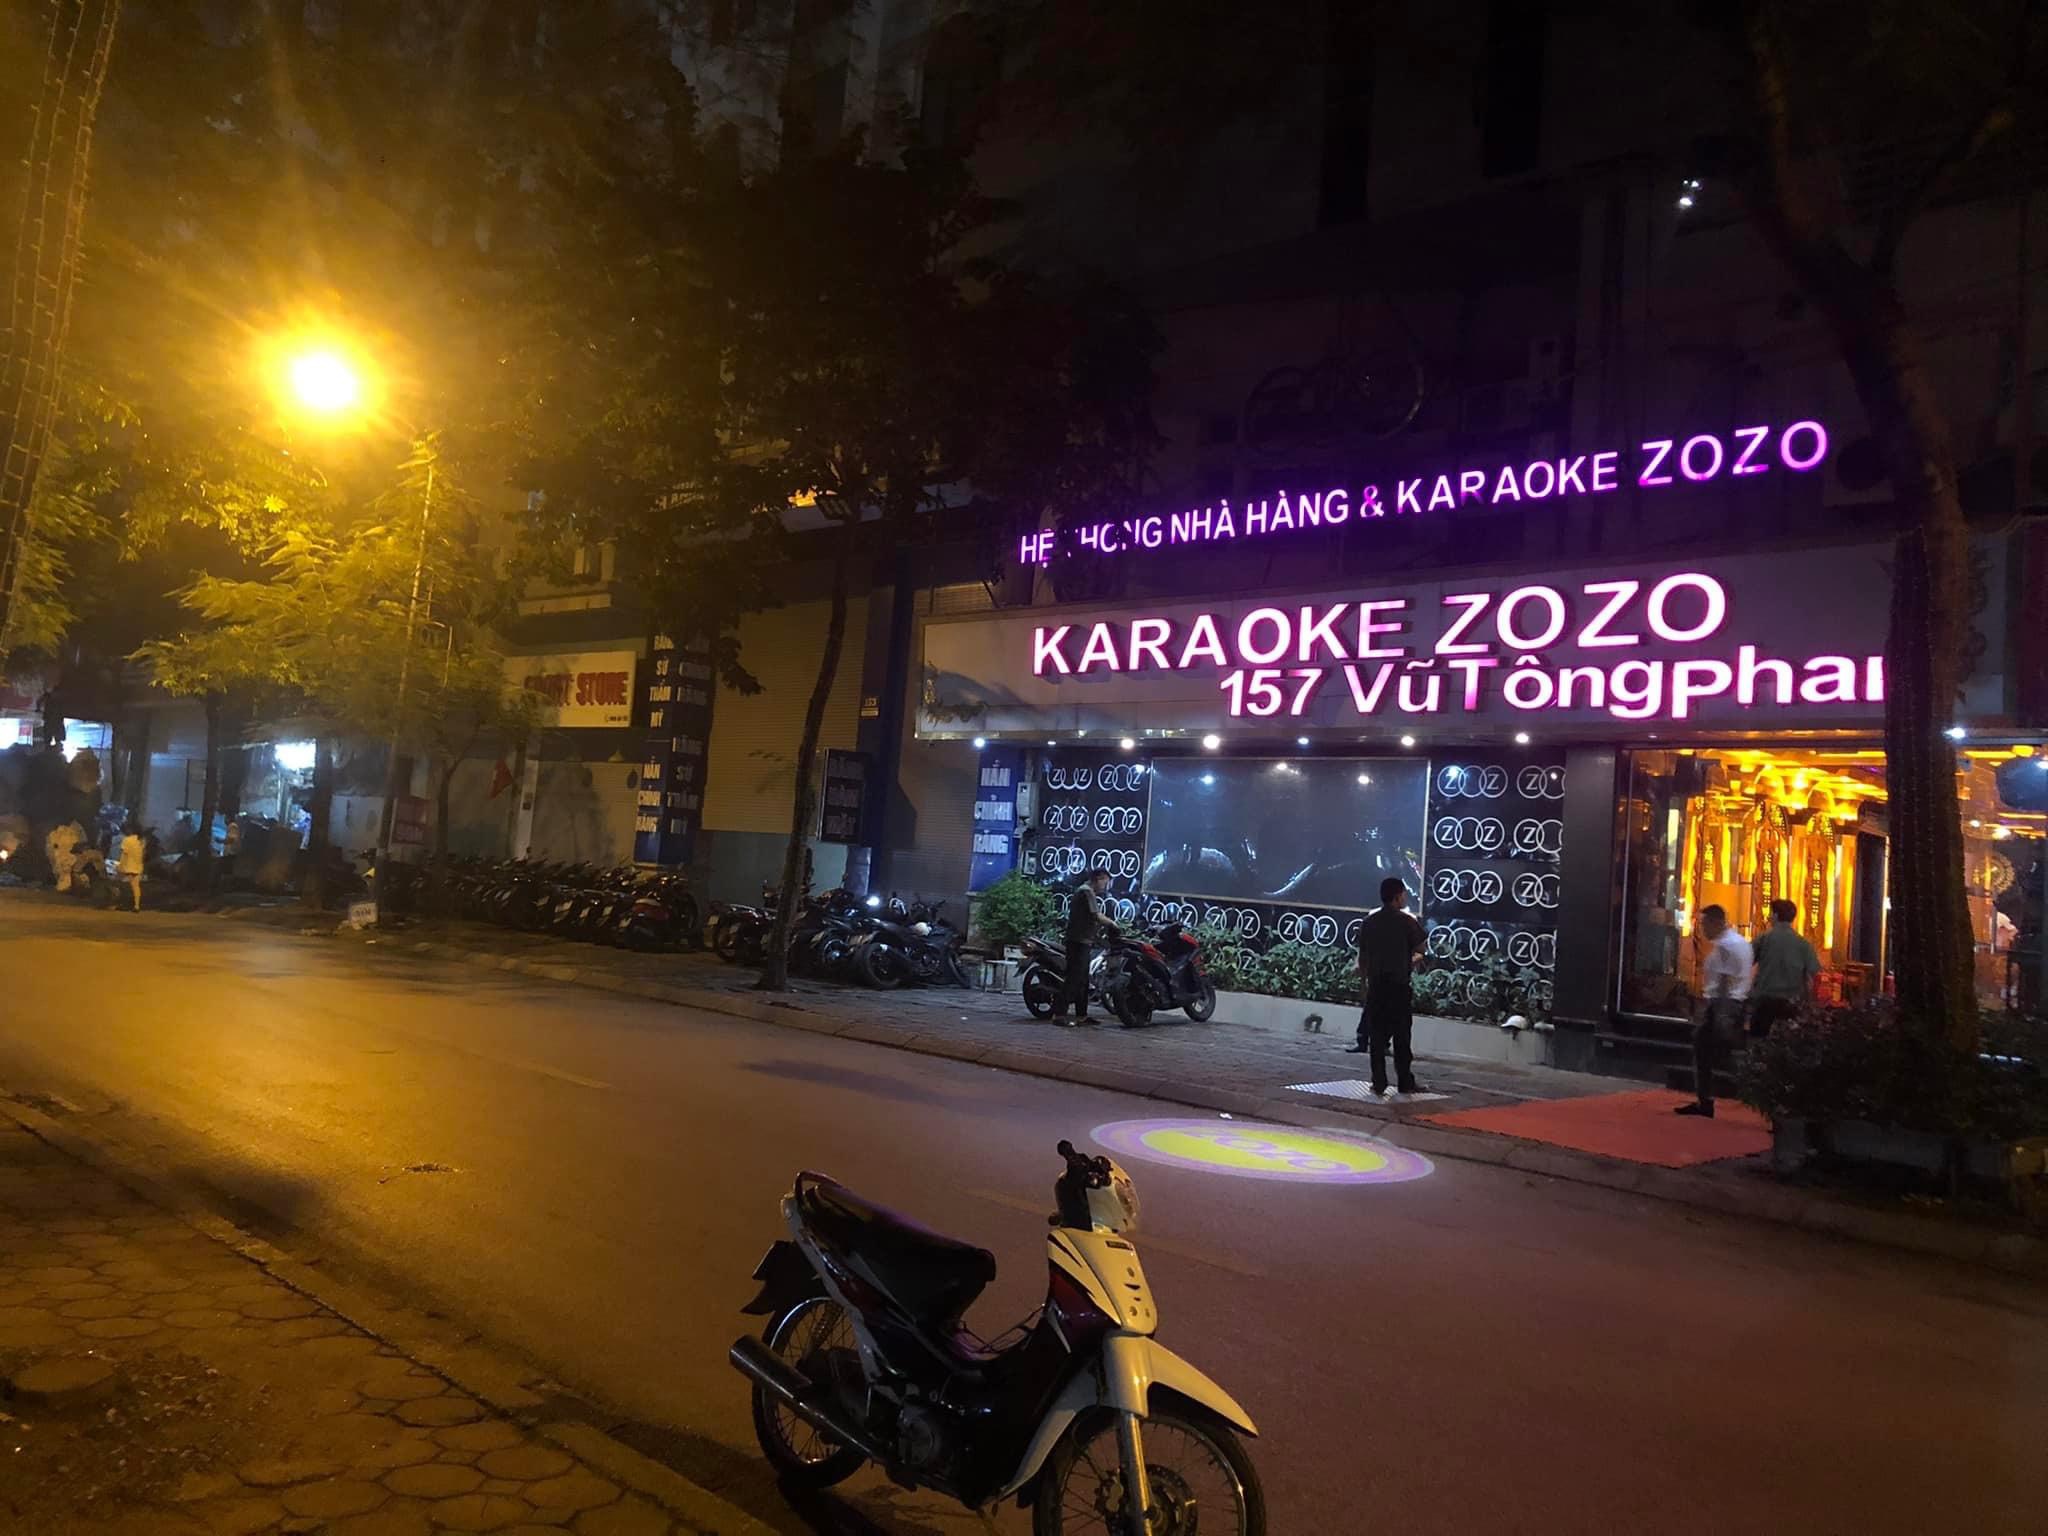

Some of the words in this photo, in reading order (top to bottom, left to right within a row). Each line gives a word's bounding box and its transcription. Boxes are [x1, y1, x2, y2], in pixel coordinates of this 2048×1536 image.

[1171, 499, 1236, 543] NHÀ
[1246, 488, 1349, 535] HÀNG
[1360, 484, 1385, 519] &
[1397, 451, 1619, 514] KARAOKE
[1638, 420, 1828, 487] ZOZO
[1032, 599, 1406, 677] KARAOKE
[1434, 572, 1727, 656] ZOZO
[1218, 667, 1324, 717] 157
